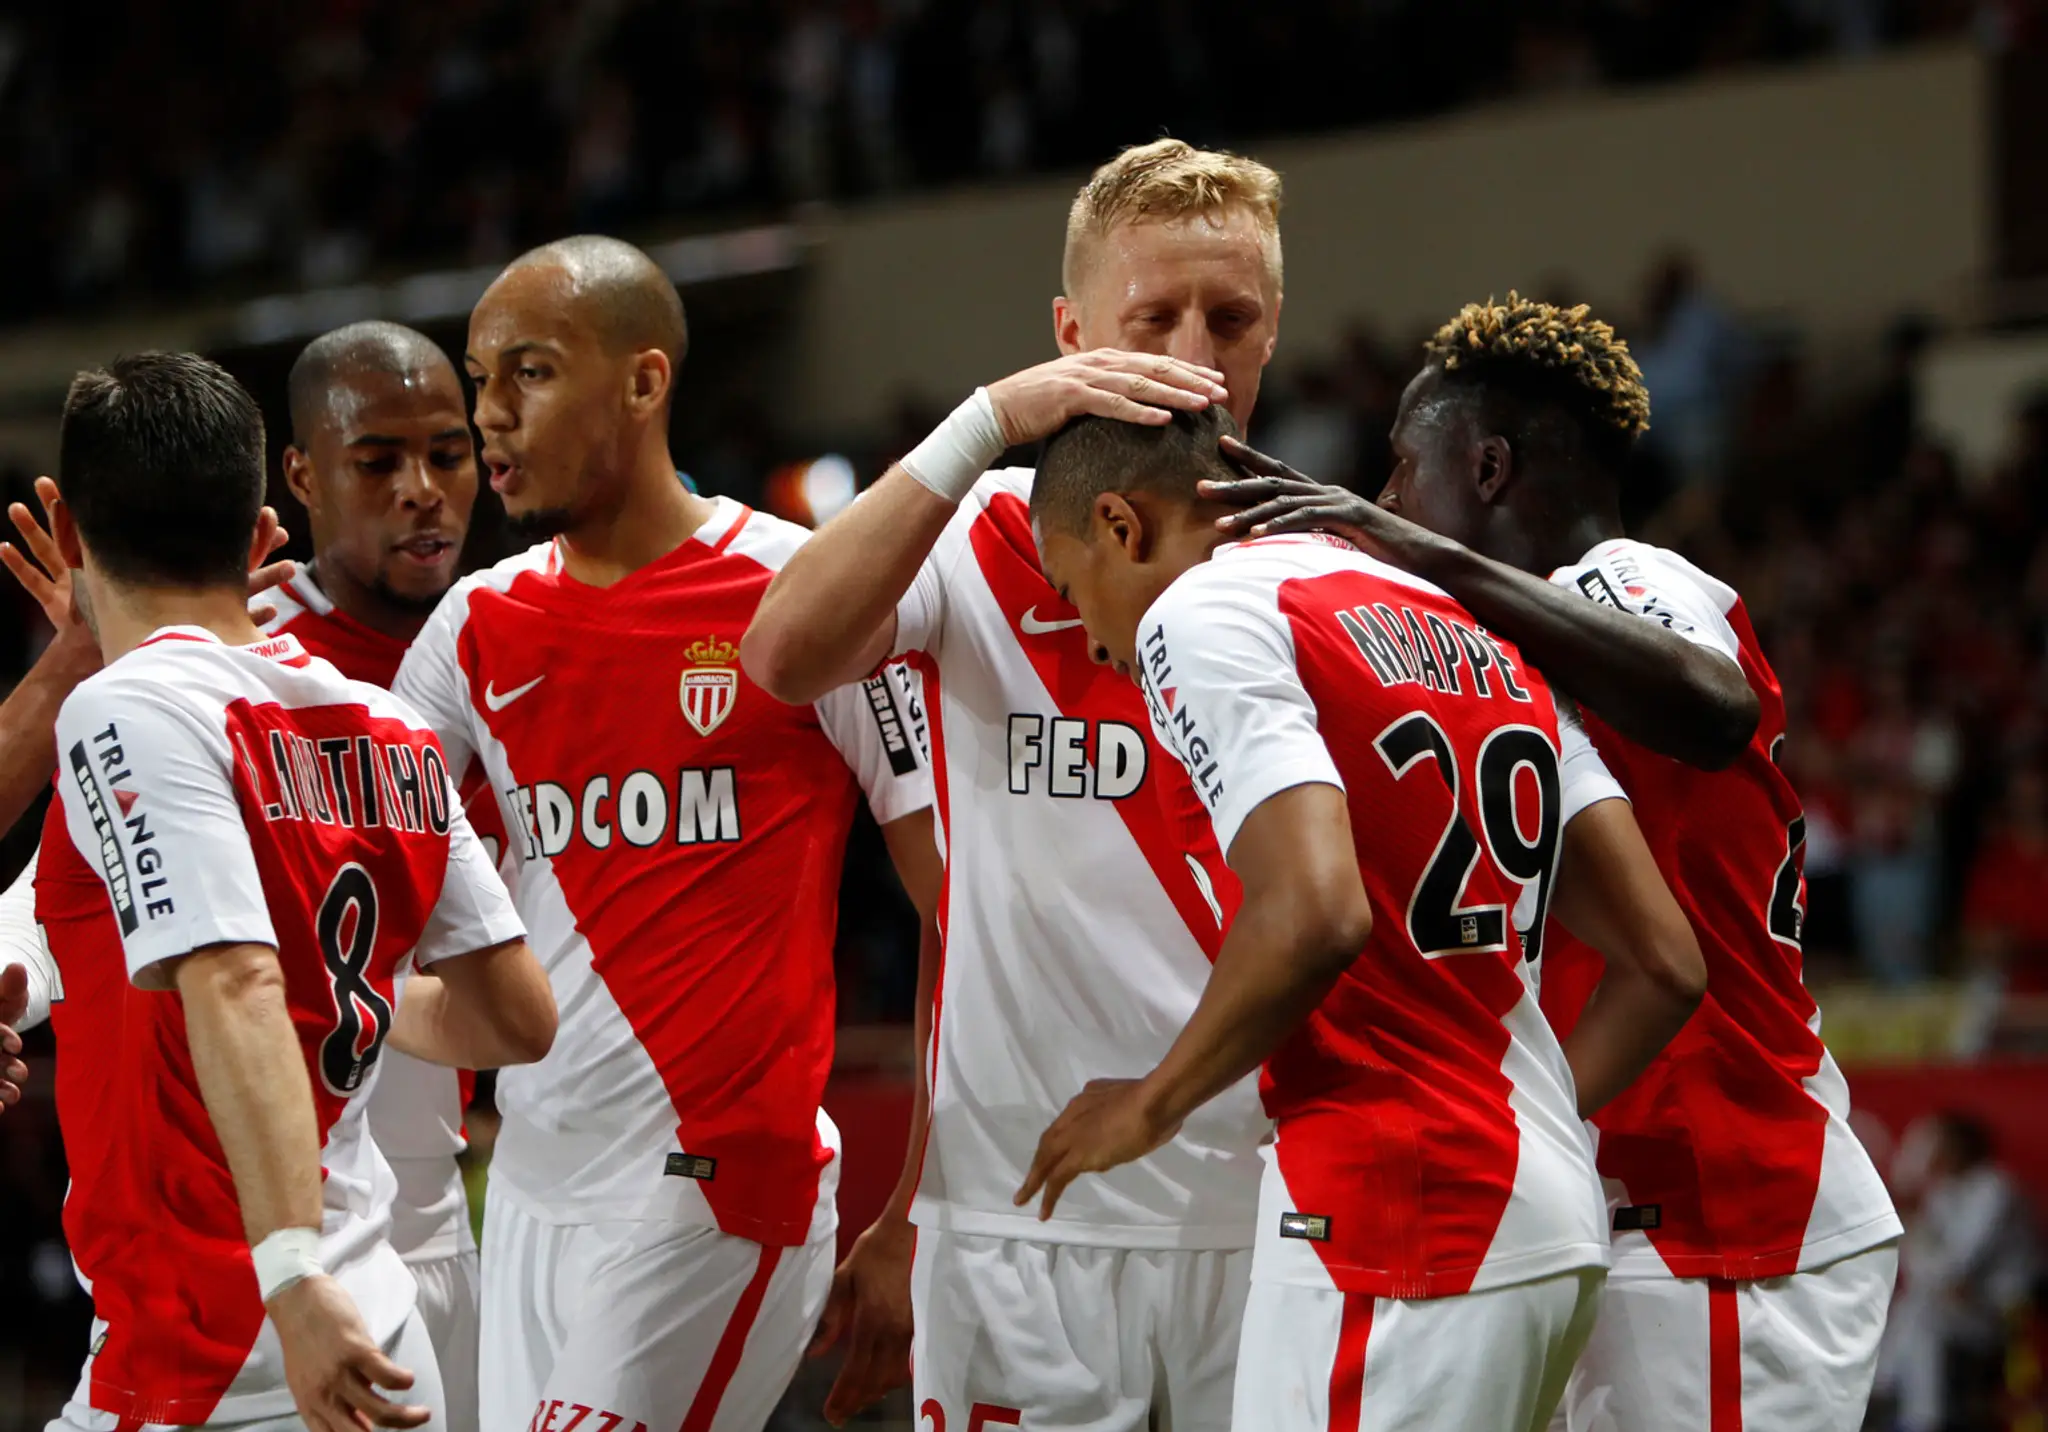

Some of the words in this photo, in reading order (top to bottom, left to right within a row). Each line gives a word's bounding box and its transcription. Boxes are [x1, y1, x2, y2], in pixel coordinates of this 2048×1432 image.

[250, 639, 290, 658] ONACO
[1145, 623, 1224, 808] TRIANGLE
[93, 722, 175, 920] TRIANGLE
[506, 765, 742, 861] EDCOM
[1371, 709, 1560, 966] 29
[316, 860, 392, 1098] 8
